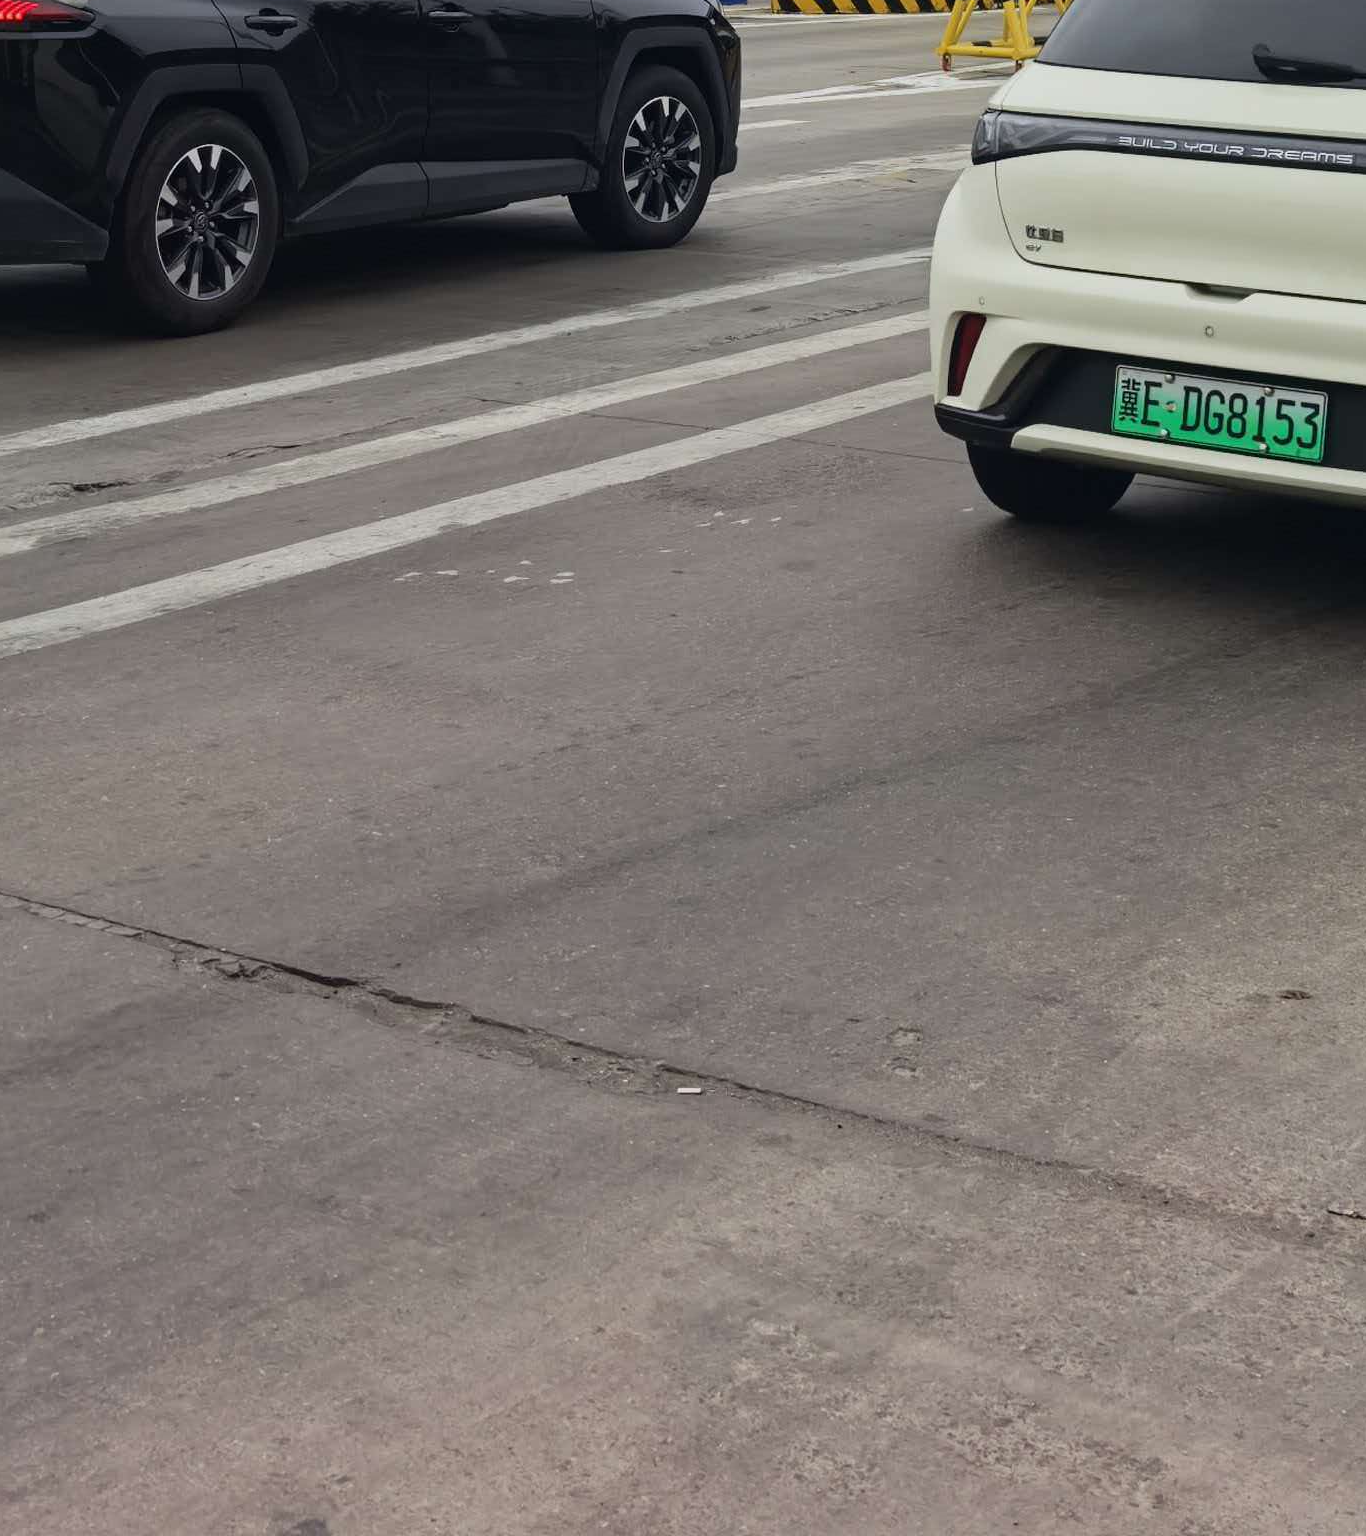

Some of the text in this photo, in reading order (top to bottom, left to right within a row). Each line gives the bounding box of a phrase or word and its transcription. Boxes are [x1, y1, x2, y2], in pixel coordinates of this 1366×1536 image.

[1118, 135, 1356, 165] BUILD YOUR DREAMS
